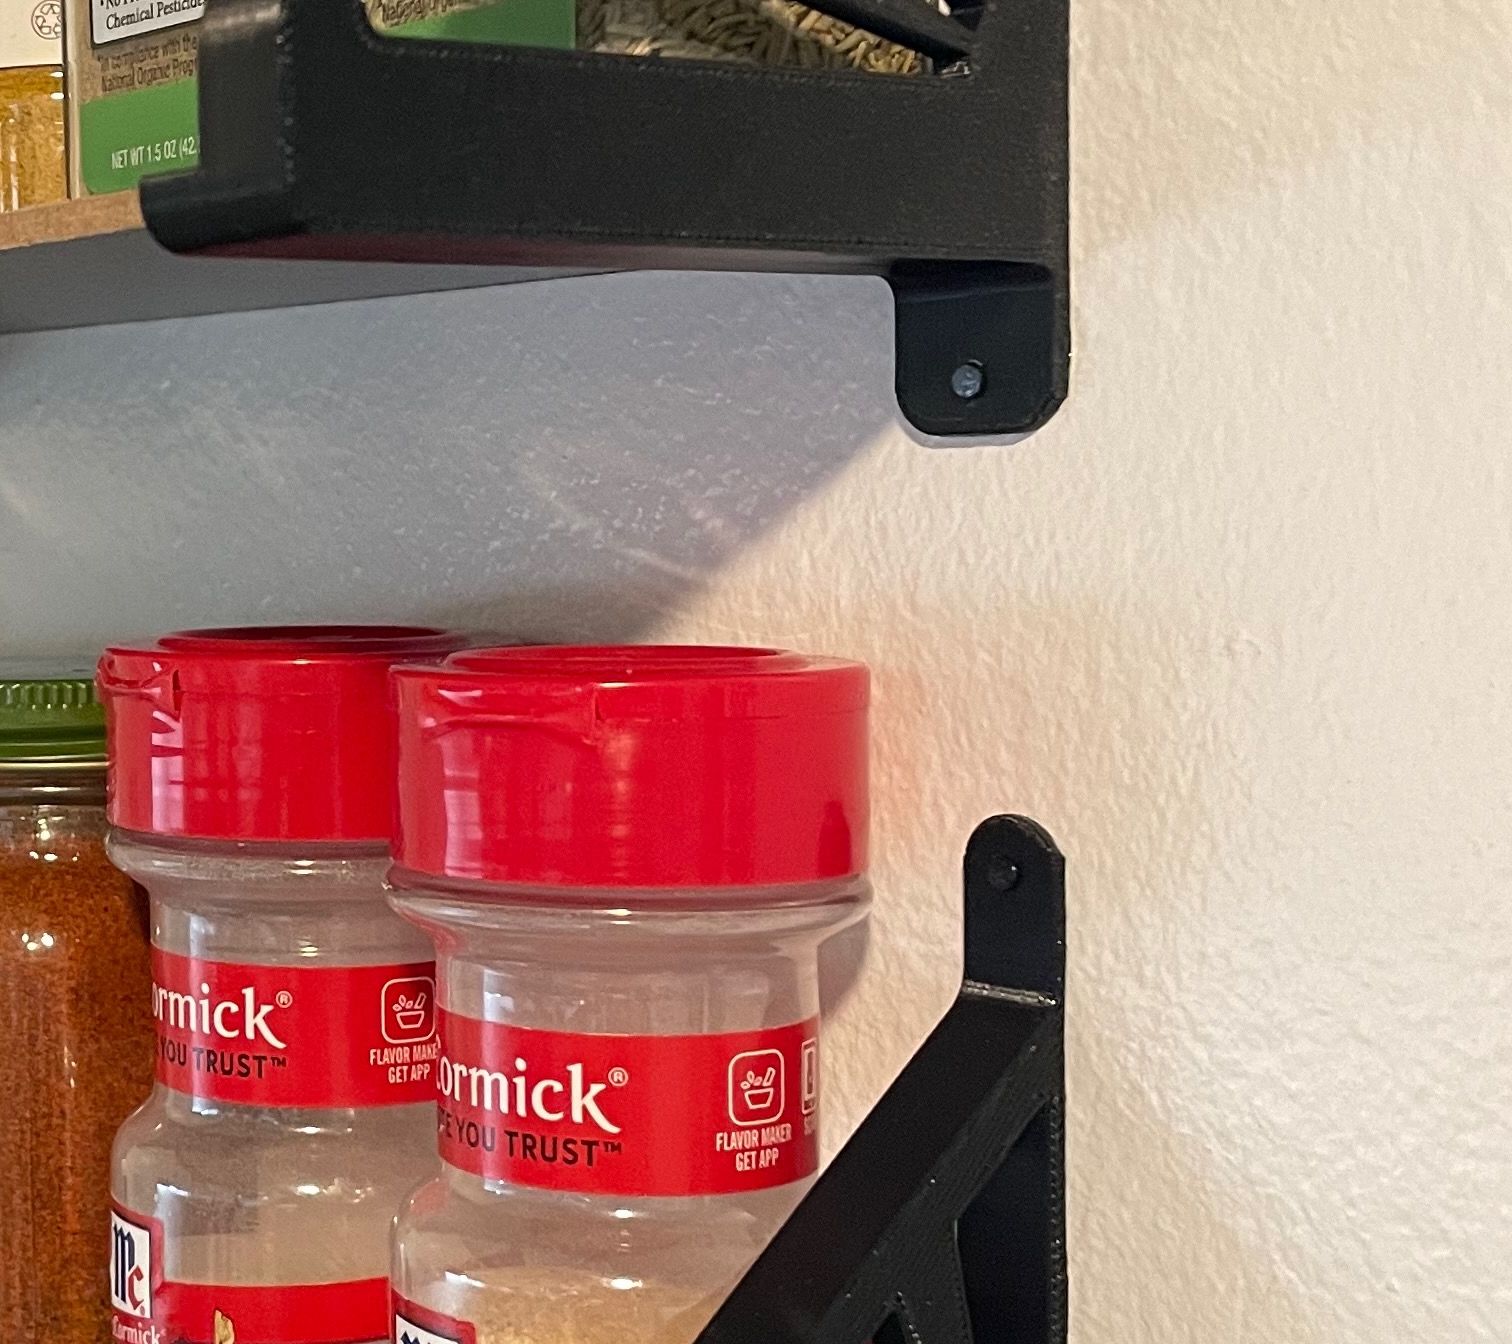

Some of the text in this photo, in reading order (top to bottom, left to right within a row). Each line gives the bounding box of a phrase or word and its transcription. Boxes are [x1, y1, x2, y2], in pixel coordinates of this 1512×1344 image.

[106, 3, 154, 30] Chemical
[111, 149, 128, 169] NET
[130, 146, 145, 166] WT
[147, 143, 162, 162] 1.5
[164, 139, 177, 159] OZ
[193, 1047, 267, 1079] TRUST
[369, 1045, 410, 1066] FLAVOR
[388, 1063, 431, 1084] GET APP
[436, 1055, 622, 1134] ormick
[456, 1117, 496, 1152] YOU
[504, 1129, 600, 1167] TRUST
[715, 1128, 760, 1152] FLAVOR
[761, 1122, 793, 1146] MAKER
[735, 1147, 780, 1172] GET APP
